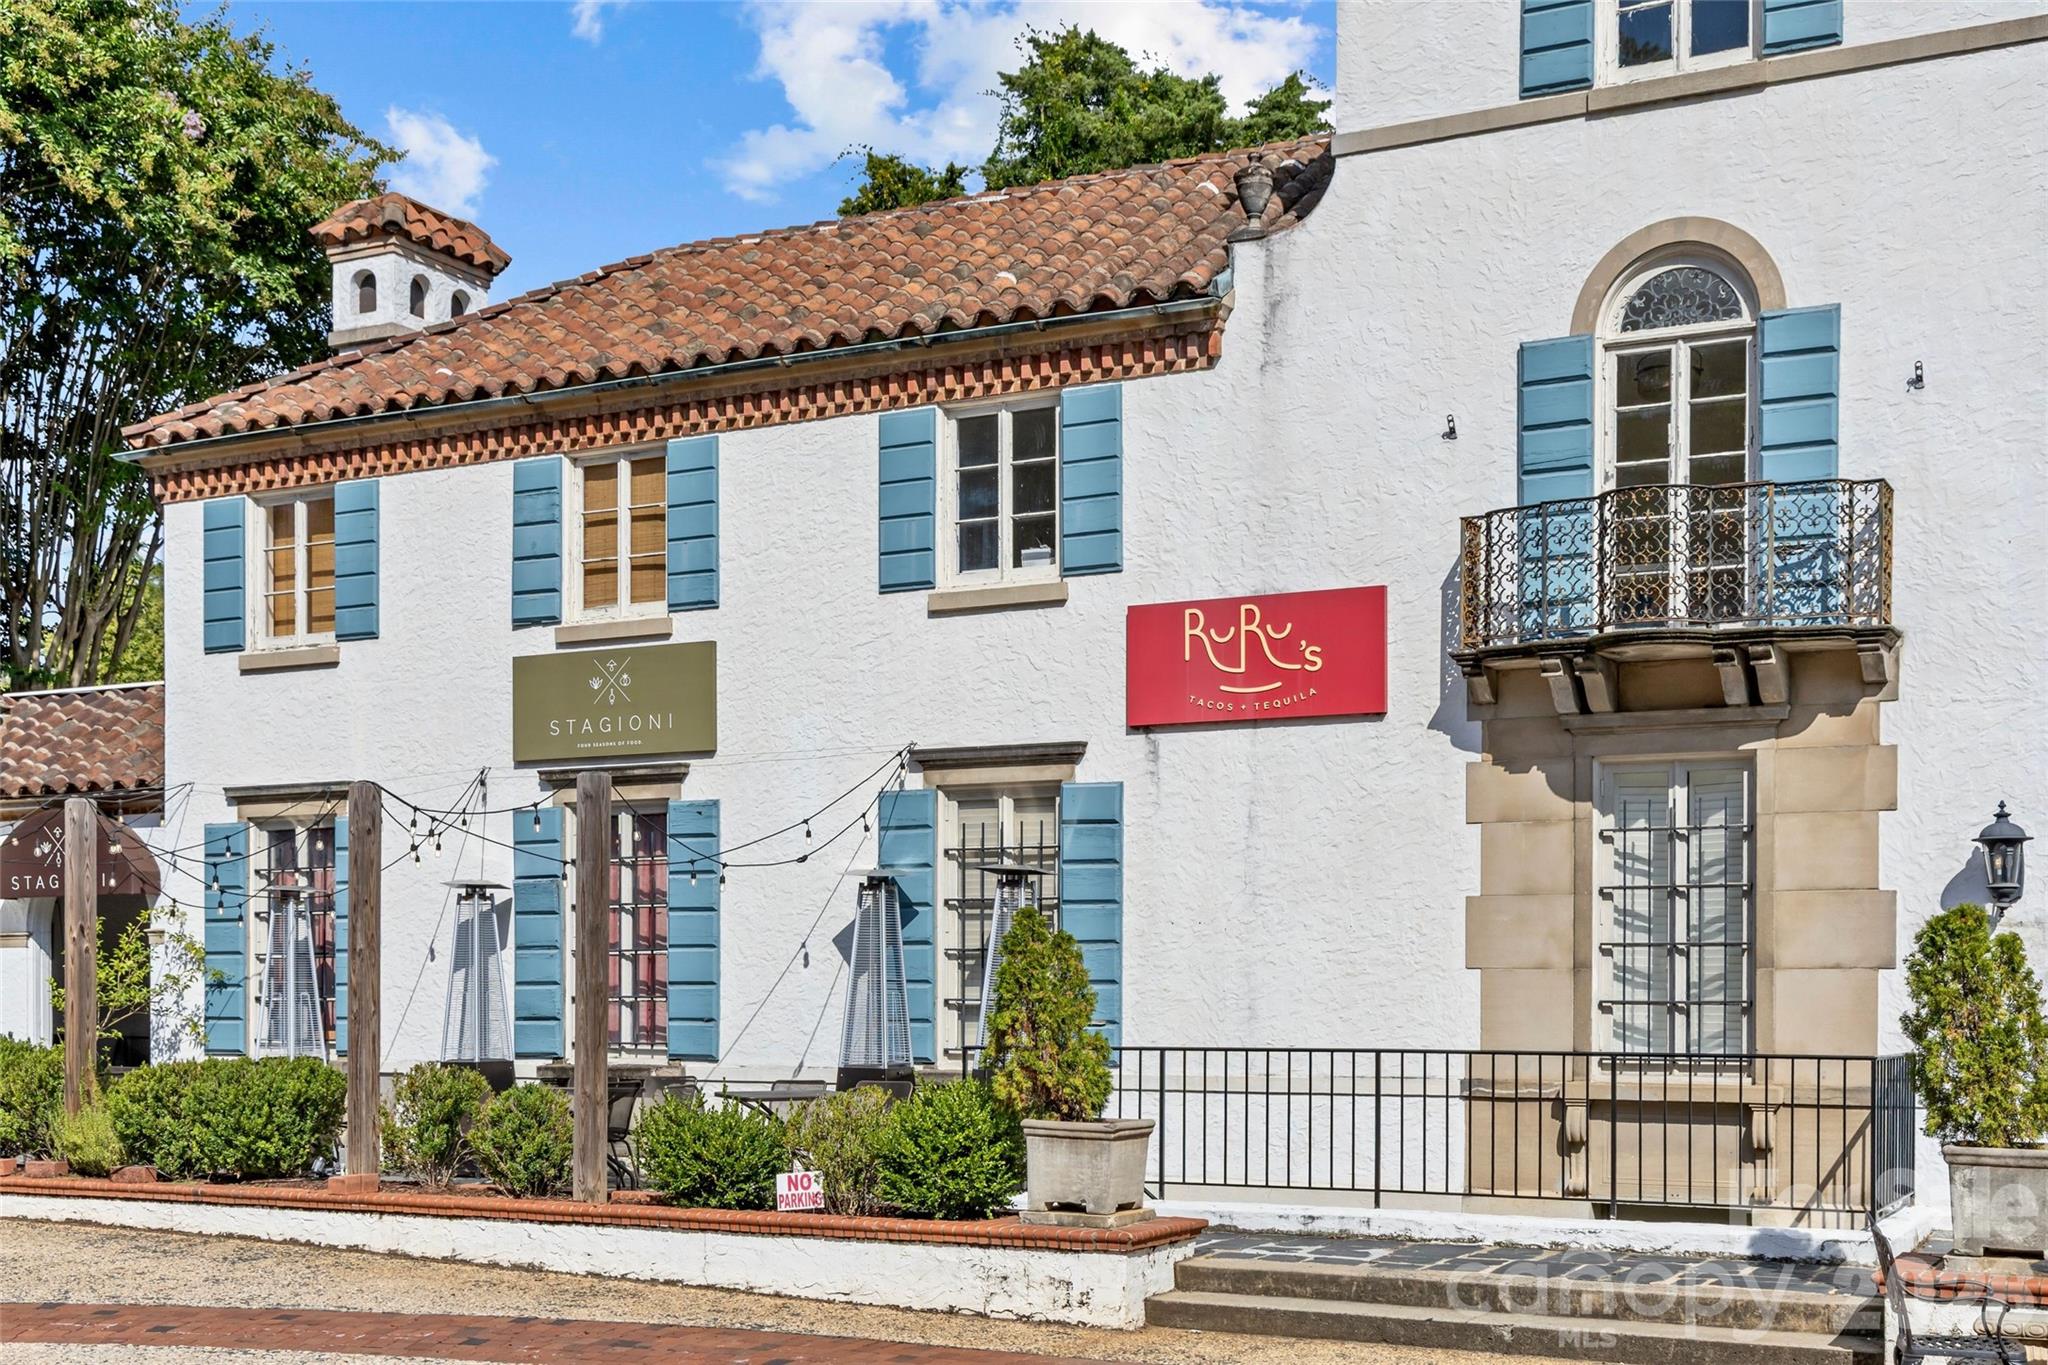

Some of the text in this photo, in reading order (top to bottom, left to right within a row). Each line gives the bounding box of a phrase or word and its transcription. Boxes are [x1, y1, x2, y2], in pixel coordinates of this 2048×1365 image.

[1190, 695, 1233, 711] TACOS
[1254, 687, 1318, 711] TEQUILA
[549, 713, 673, 736] STAGIONI
[11, 873, 105, 891] STAGI
[787, 1173, 812, 1192] NO
[778, 1191, 823, 1209] PARKING
